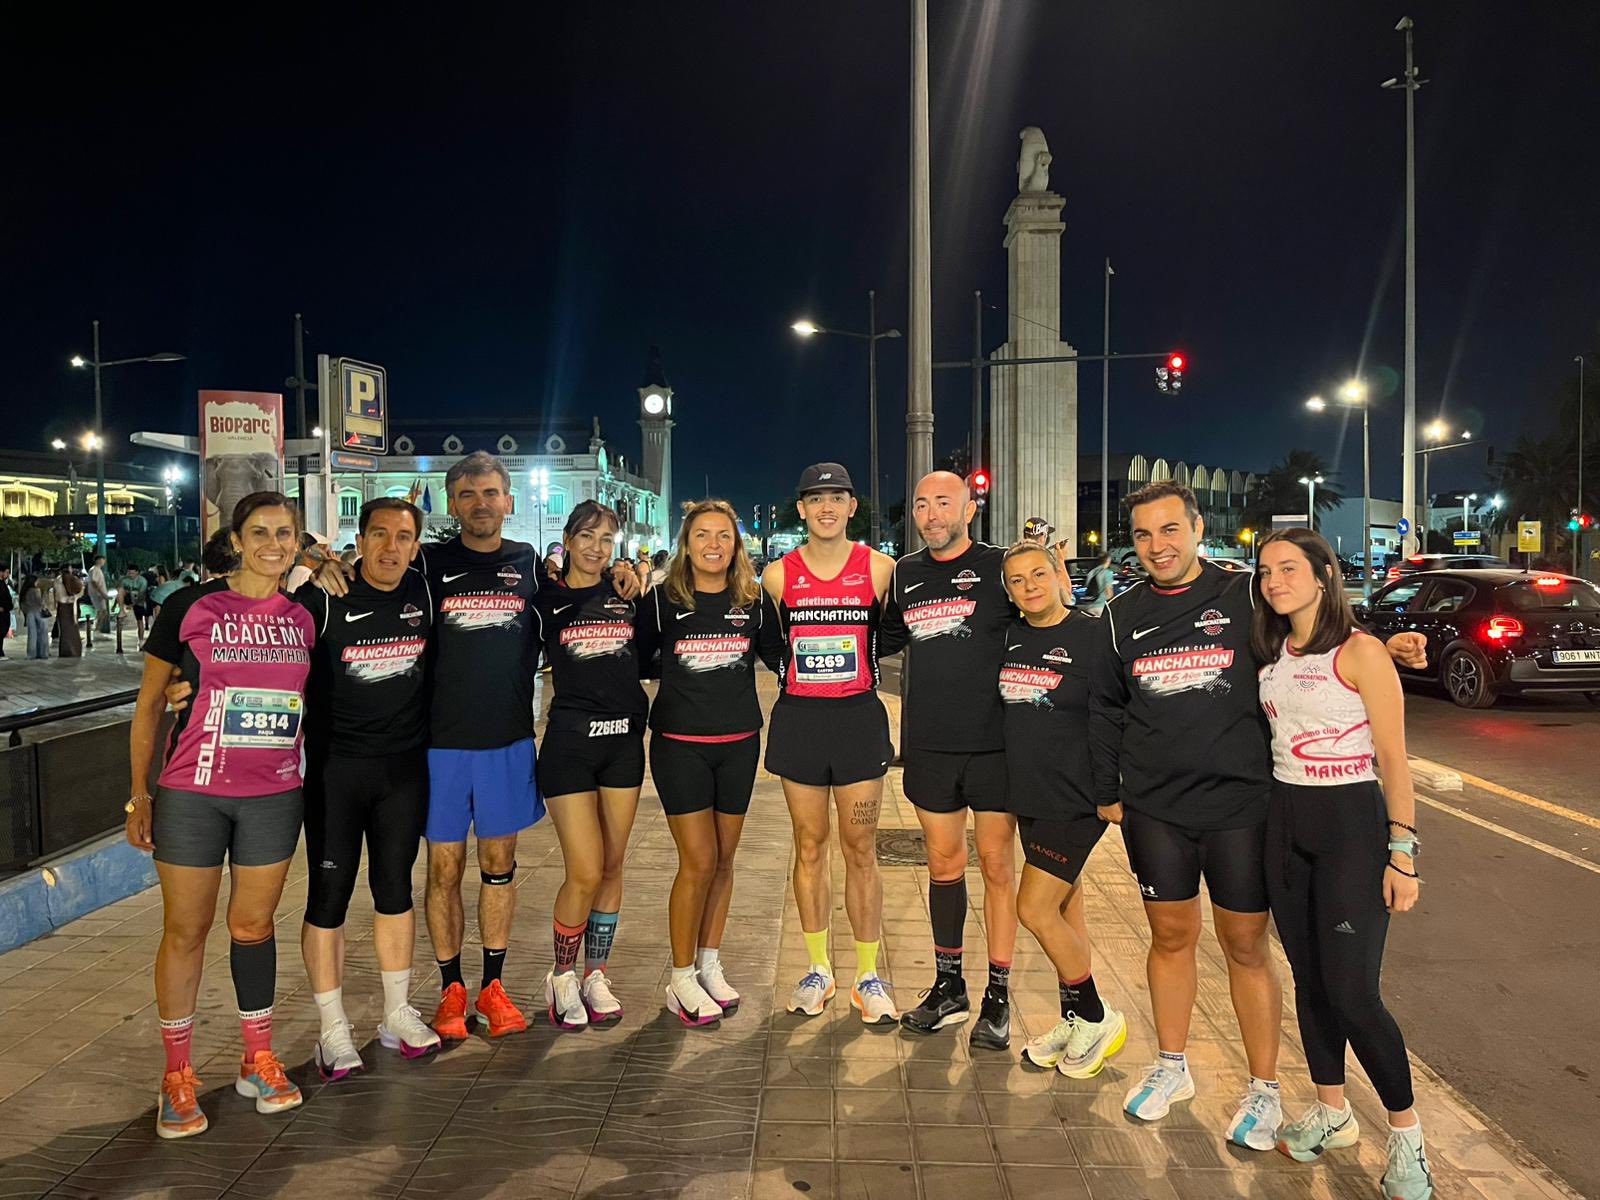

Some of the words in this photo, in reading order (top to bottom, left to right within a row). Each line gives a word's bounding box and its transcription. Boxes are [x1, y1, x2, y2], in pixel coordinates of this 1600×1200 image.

[350, 371, 375, 415] P
[444, 599, 522, 610] MANCHATHON
[796, 596, 838, 606] atletismo
[841, 596, 861, 605] club
[224, 612, 294, 624] ATLETISMO
[790, 610, 868, 622] MANCHATHON
[210, 622, 306, 647] ACADEMY
[562, 627, 633, 641] MANCHATHON
[345, 643, 424, 659] MANCHATHON
[677, 641, 748, 652] MANCHATHON
[211, 647, 310, 663] MANCHATHON
[805, 655, 845, 668] 6269
[1560, 652, 1580, 660] 9061
[1135, 653, 1229, 673] MANCHATHON
[240, 712, 288, 729] 3814
[589, 718, 629, 737] 226ERS
[194, 690, 224, 786] SOLISS
